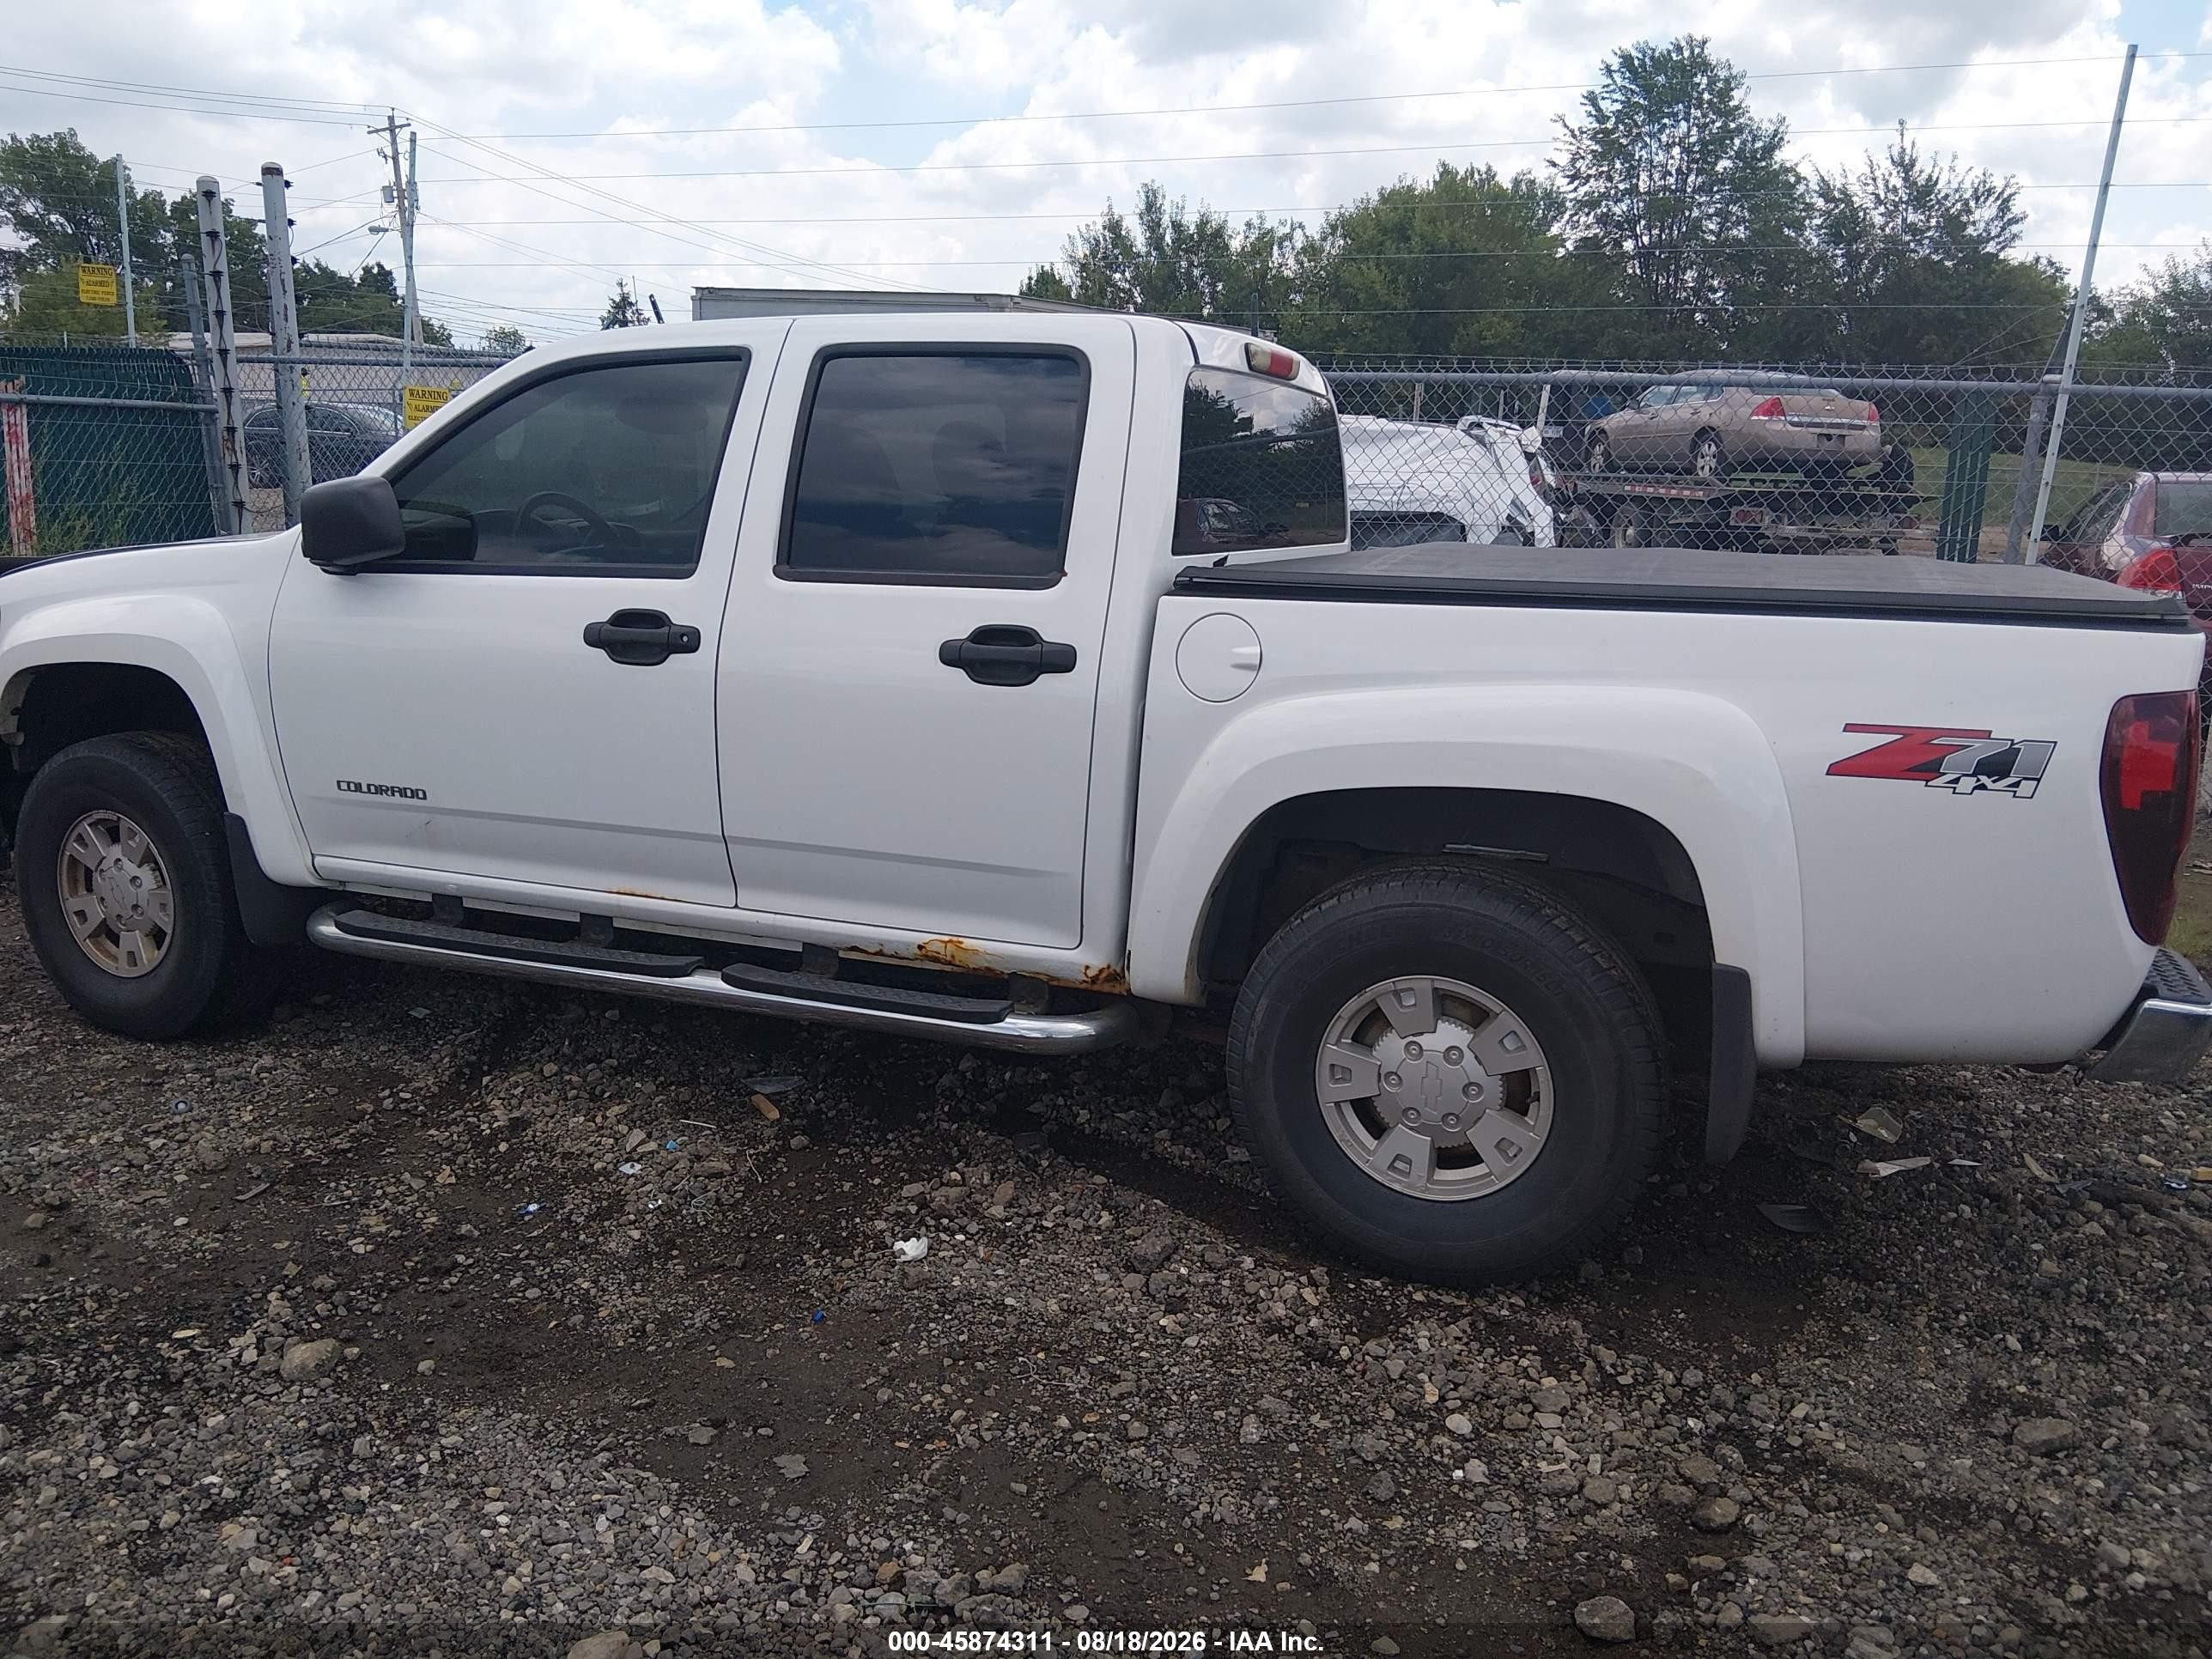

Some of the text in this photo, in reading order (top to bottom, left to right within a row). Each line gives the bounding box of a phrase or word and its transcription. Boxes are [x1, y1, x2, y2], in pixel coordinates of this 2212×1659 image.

[82, 266, 113, 276] WARNING
[408, 388, 448, 401] WARNING
[1826, 722, 2058, 781] Z71
[336, 780, 428, 800] COLORADO
